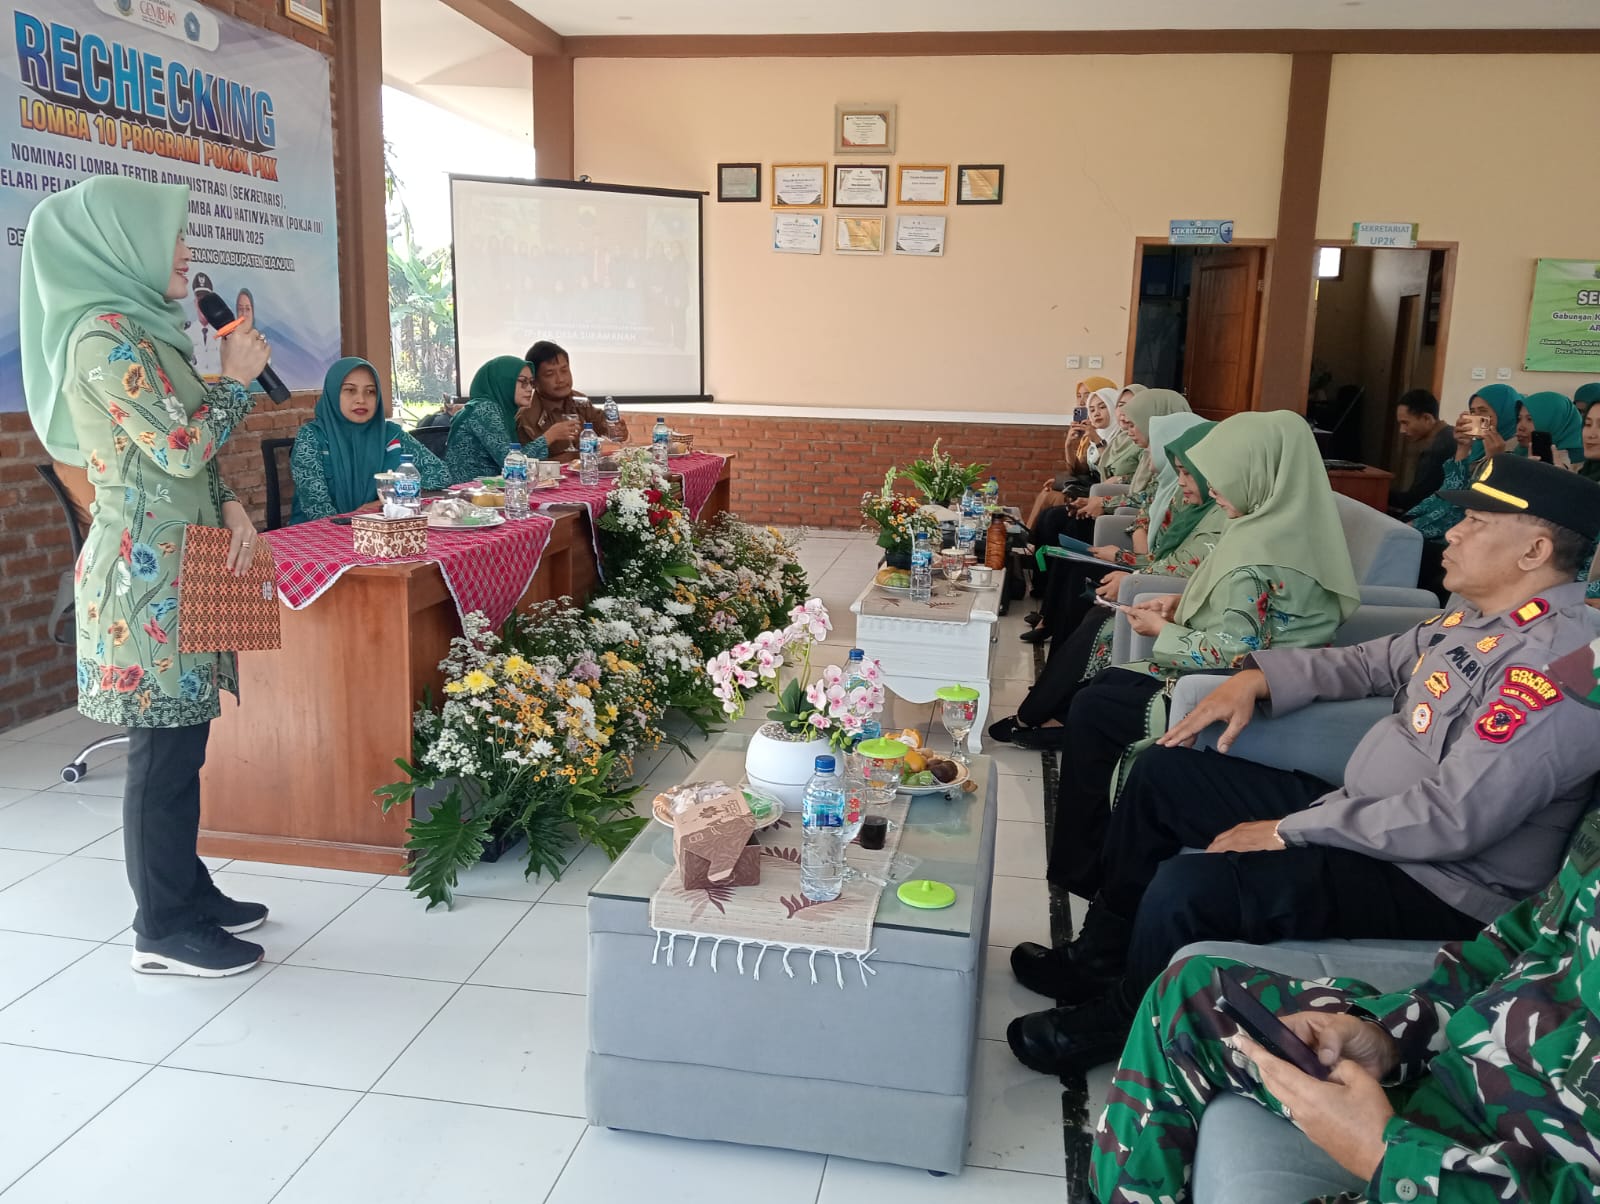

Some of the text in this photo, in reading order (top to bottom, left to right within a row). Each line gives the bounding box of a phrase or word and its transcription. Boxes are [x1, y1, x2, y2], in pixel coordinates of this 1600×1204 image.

[14, 10, 276, 149] RECHECKING
[20, 96, 279, 182] LOMBA 10 PROGRAM POKOK PKK
[11, 142, 77, 170] NOMINASI
[80, 156, 119, 176] LOMBA
[122, 164, 159, 184] TERTIB
[161, 171, 228, 198] ADMINISTRASI
[0, 168, 38, 191] ELARI
[214, 204, 233, 220] AKU
[234, 207, 270, 226] HATINYA
[270, 213, 285, 229] PKK
[214, 225, 245, 244] TAHUN
[246, 230, 264, 245] 2025
[1171, 226, 1218, 236] SEKRETARIAT
[1360, 224, 1410, 233] SEKRETARIAT
[190, 247, 219, 264] ENANG
[219, 249, 263, 269] KABUPATEN
[263, 255, 295, 272] CIANJUR
[1552, 312, 1592, 321] Gabungan
[1445, 645, 1481, 682] POLRI
[1511, 669, 1557, 698] POLRES
